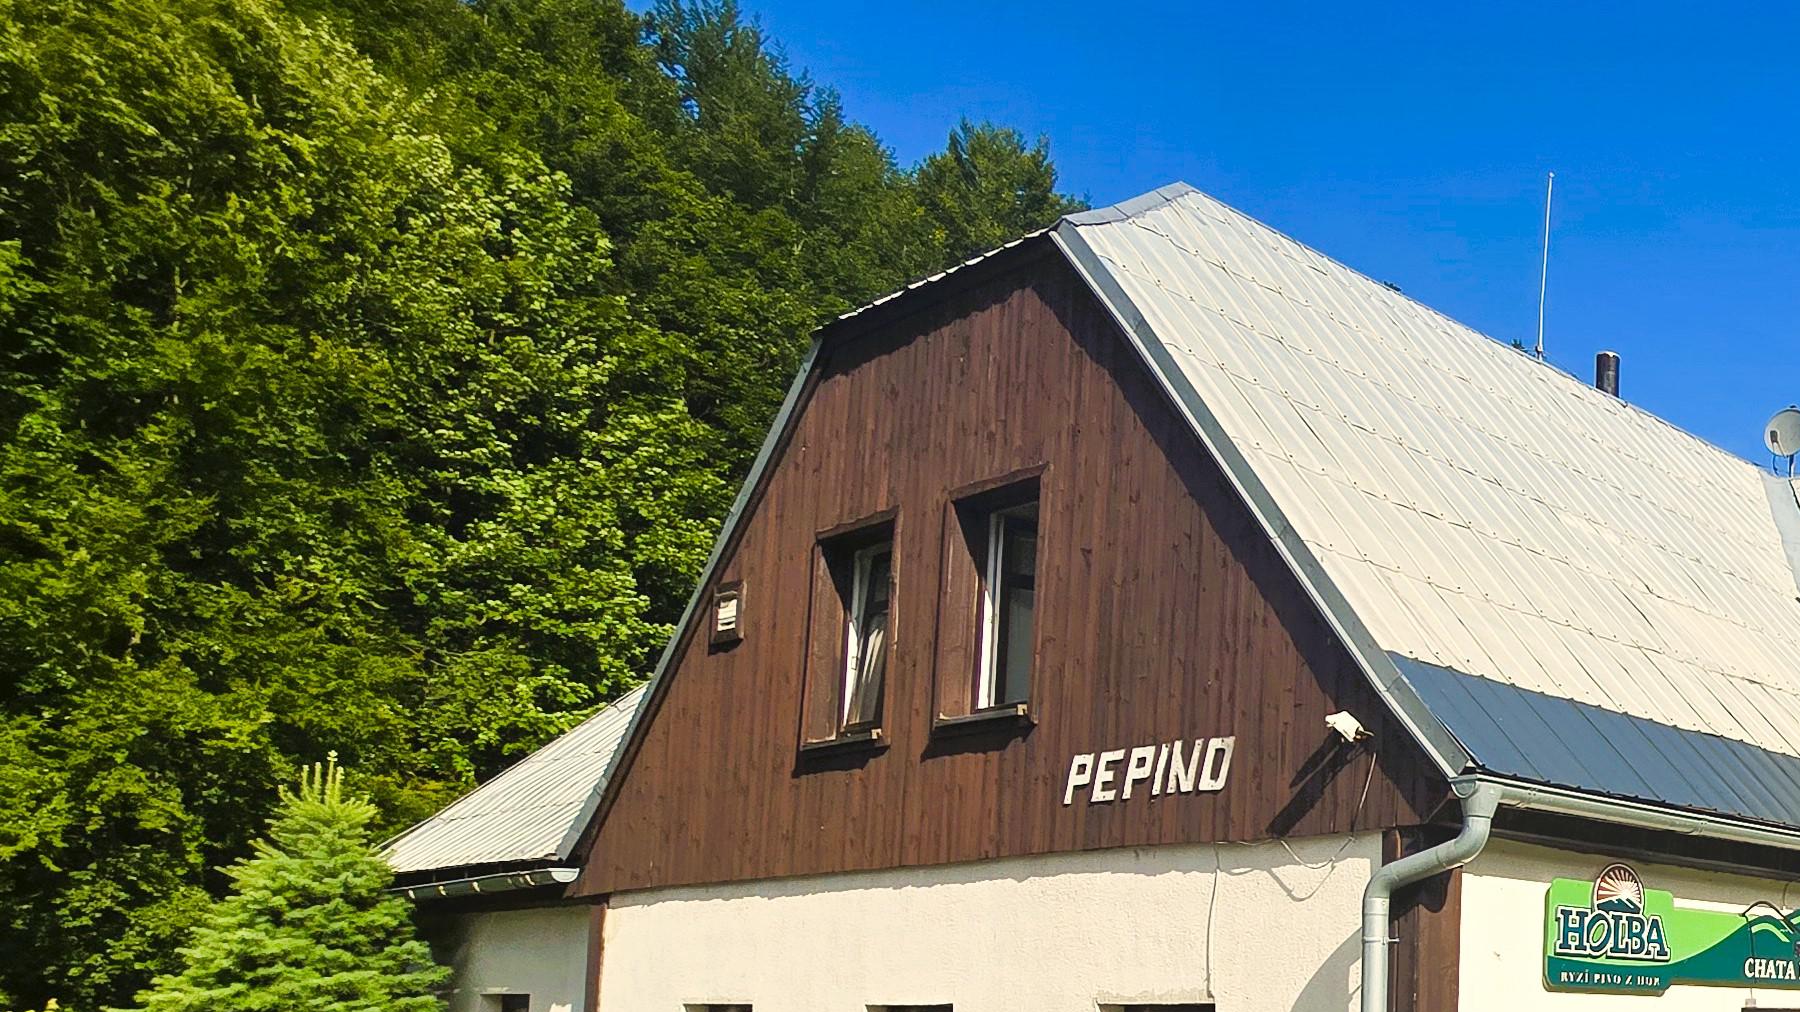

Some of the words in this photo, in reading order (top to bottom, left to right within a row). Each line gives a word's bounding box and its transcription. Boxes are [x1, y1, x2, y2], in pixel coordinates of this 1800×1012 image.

[1063, 735, 1236, 805] PEPINO
[1556, 905, 1671, 960] HOLBA
[1593, 973, 1621, 985] PIVO
[1744, 957, 1797, 980] CHATA
